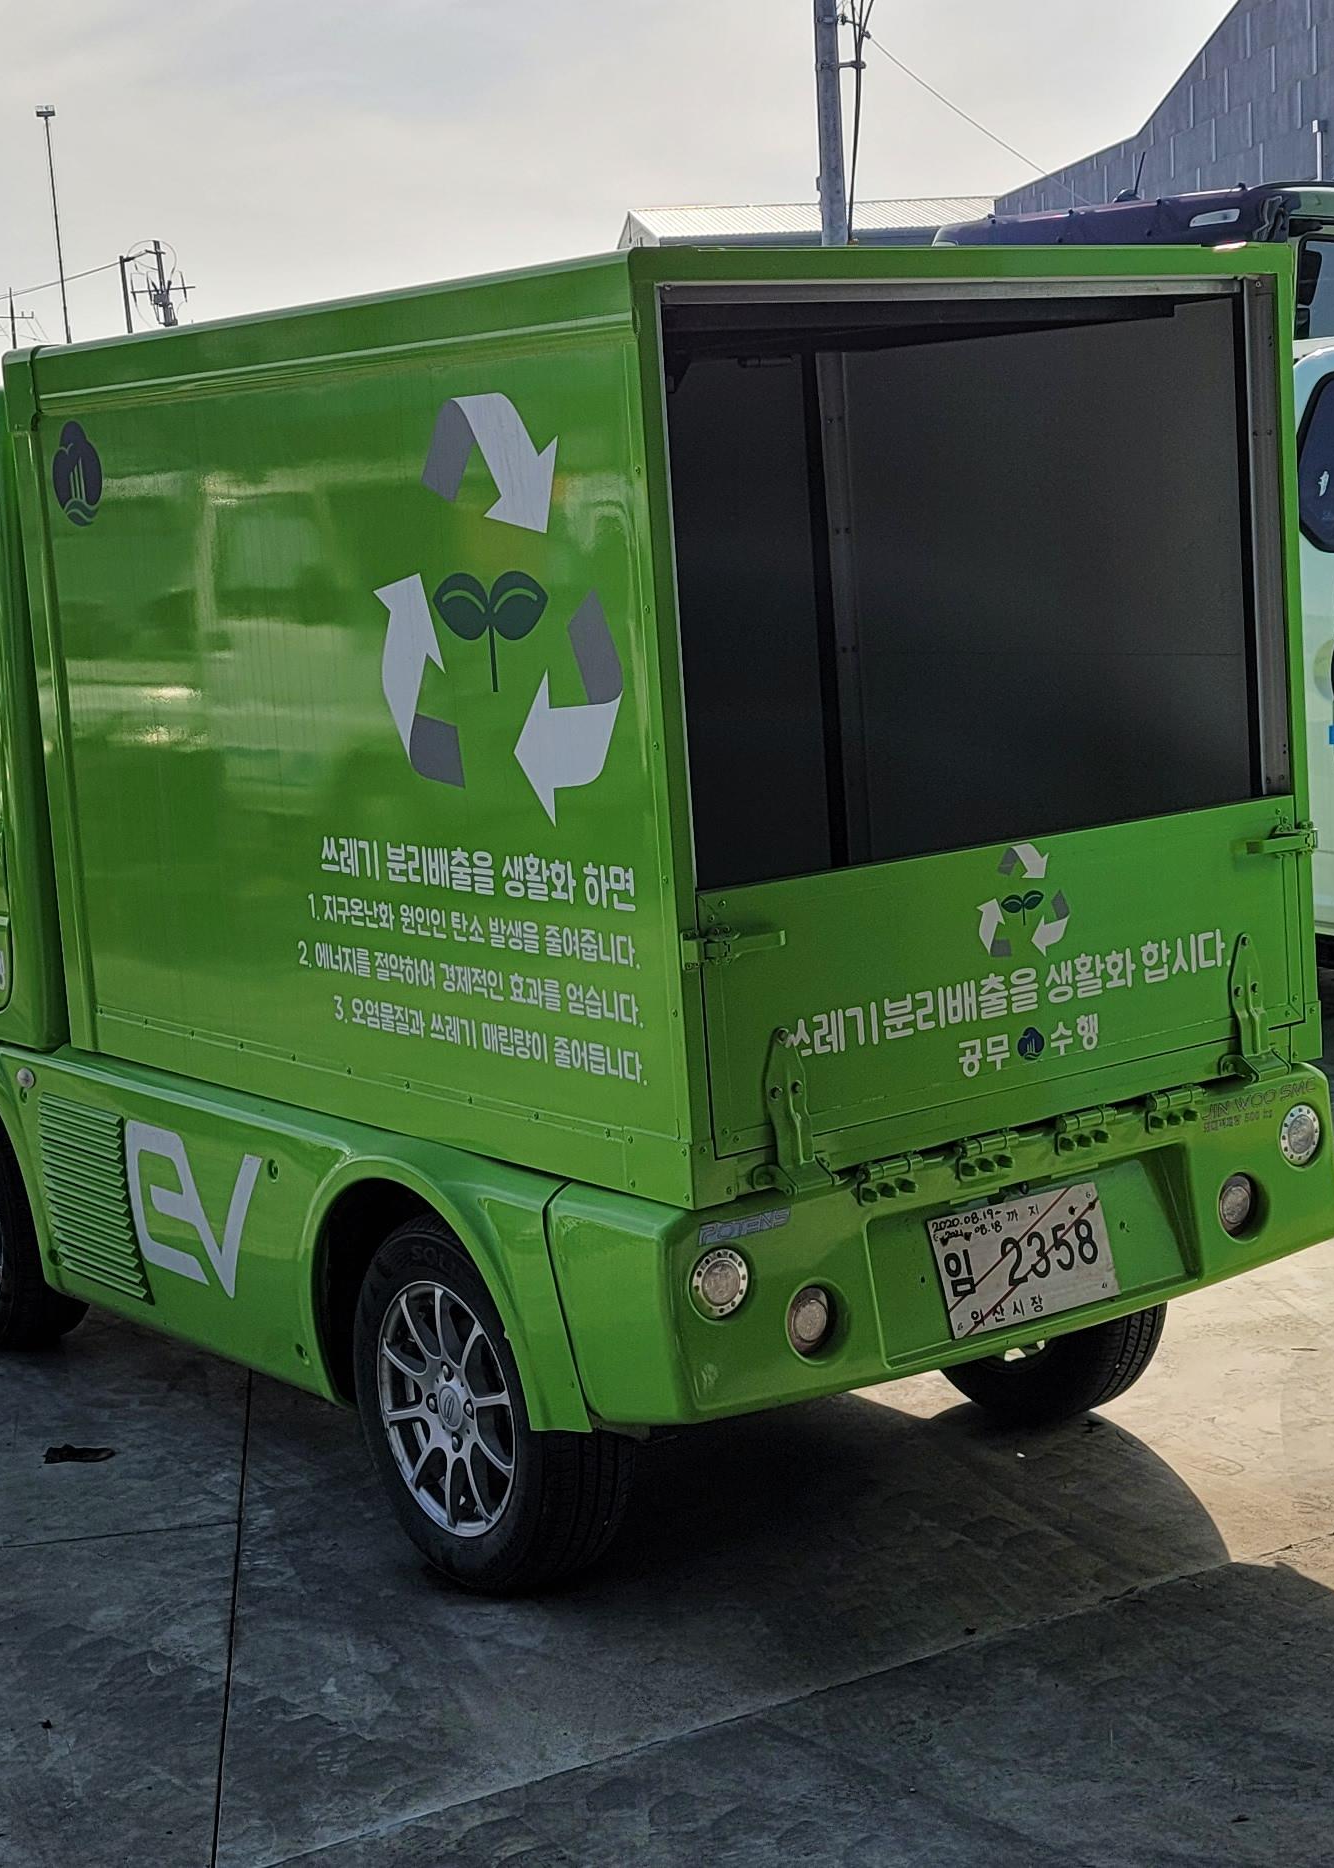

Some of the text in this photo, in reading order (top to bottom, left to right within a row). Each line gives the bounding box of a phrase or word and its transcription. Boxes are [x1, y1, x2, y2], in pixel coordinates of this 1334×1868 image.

[320, 835, 637, 912] 쓰레기 분리배출을 생활화 하면
[322, 894, 395, 931] 지구온난화
[400, 904, 447, 940] 원인인
[450, 911, 485, 943] 탄소
[488, 916, 540, 954] 발생을
[544, 925, 641, 970] 줄여줍니다.
[1045, 947, 1136, 1004] 생활화
[1140, 928, 1232, 984] 합시다.
[315, 941, 371, 978] 에너지를
[374, 951, 436, 990] 절약하여
[439, 962, 505, 1002] 경제적인
[509, 972, 562, 1012] 효과를
[566, 982, 644, 1029] 얻습니다.
[351, 997, 426, 1039] 오염물질과
[430, 1012, 477, 1050] 쓰레기
[482, 1022, 549, 1064] 매립량이
[553, 1036, 648, 1086] 줄어듭니다.
[958, 1013, 1099, 1078] 공무 수행
[1280, 1077, 1317, 1100] SMC
[124, 1118, 263, 1300] EV
[943, 1218, 1099, 1297] 임 2358
